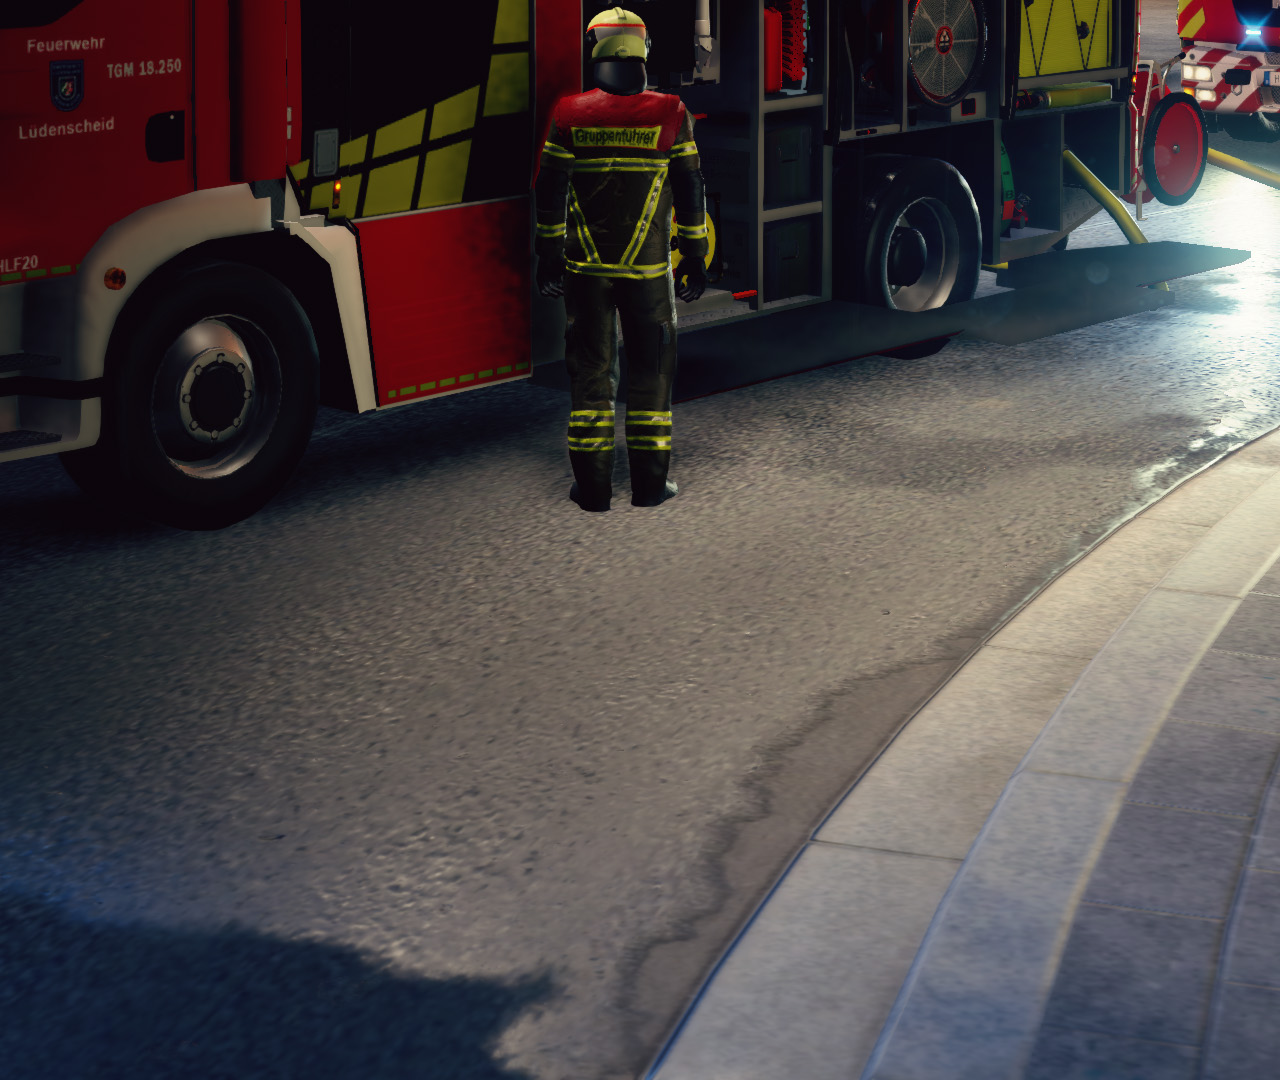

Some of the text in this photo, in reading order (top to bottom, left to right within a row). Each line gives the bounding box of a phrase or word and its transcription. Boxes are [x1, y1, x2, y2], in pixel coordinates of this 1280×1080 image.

[27, 36, 105, 53] Feuerwehr
[106, 58, 182, 79] TGM 18.250
[18, 116, 115, 140] Lüdenscheid
